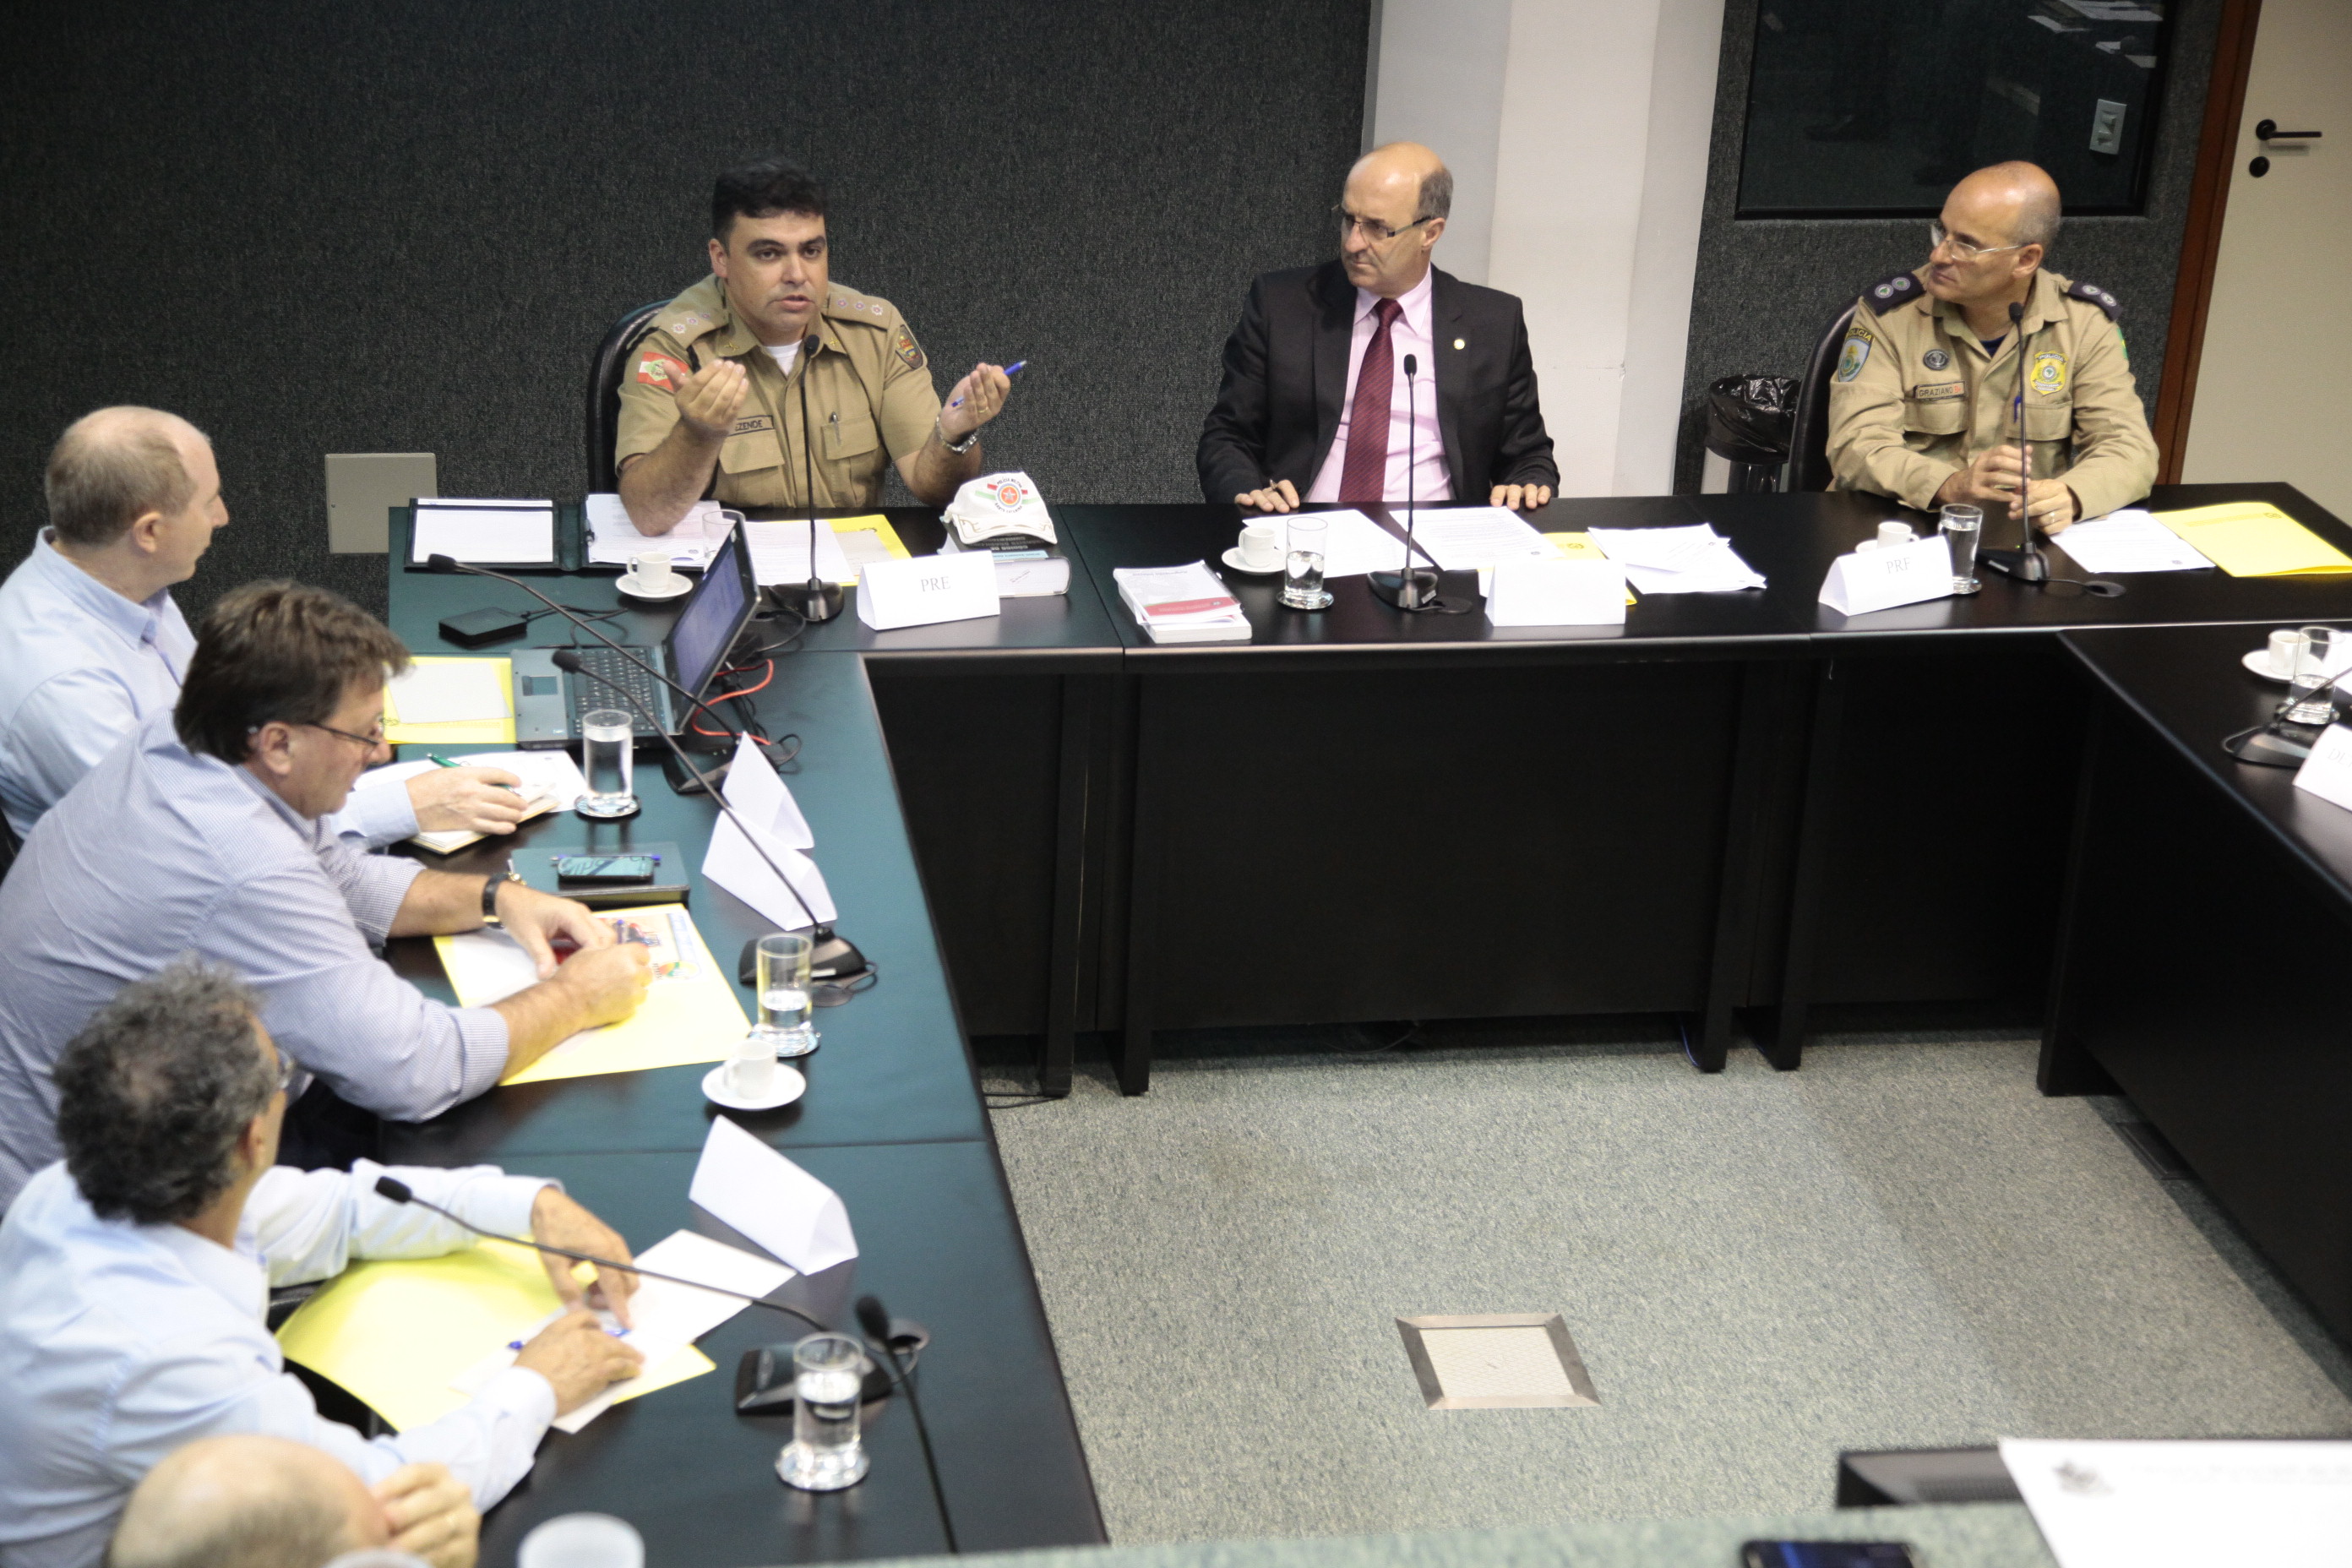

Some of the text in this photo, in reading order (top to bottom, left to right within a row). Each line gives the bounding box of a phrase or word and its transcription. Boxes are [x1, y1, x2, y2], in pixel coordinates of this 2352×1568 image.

[1919, 387, 1953, 397] GRAZIANO
[735, 419, 764, 432] EZENDE
[1886, 557, 1911, 574] PRF
[920, 575, 951, 592] PRE
